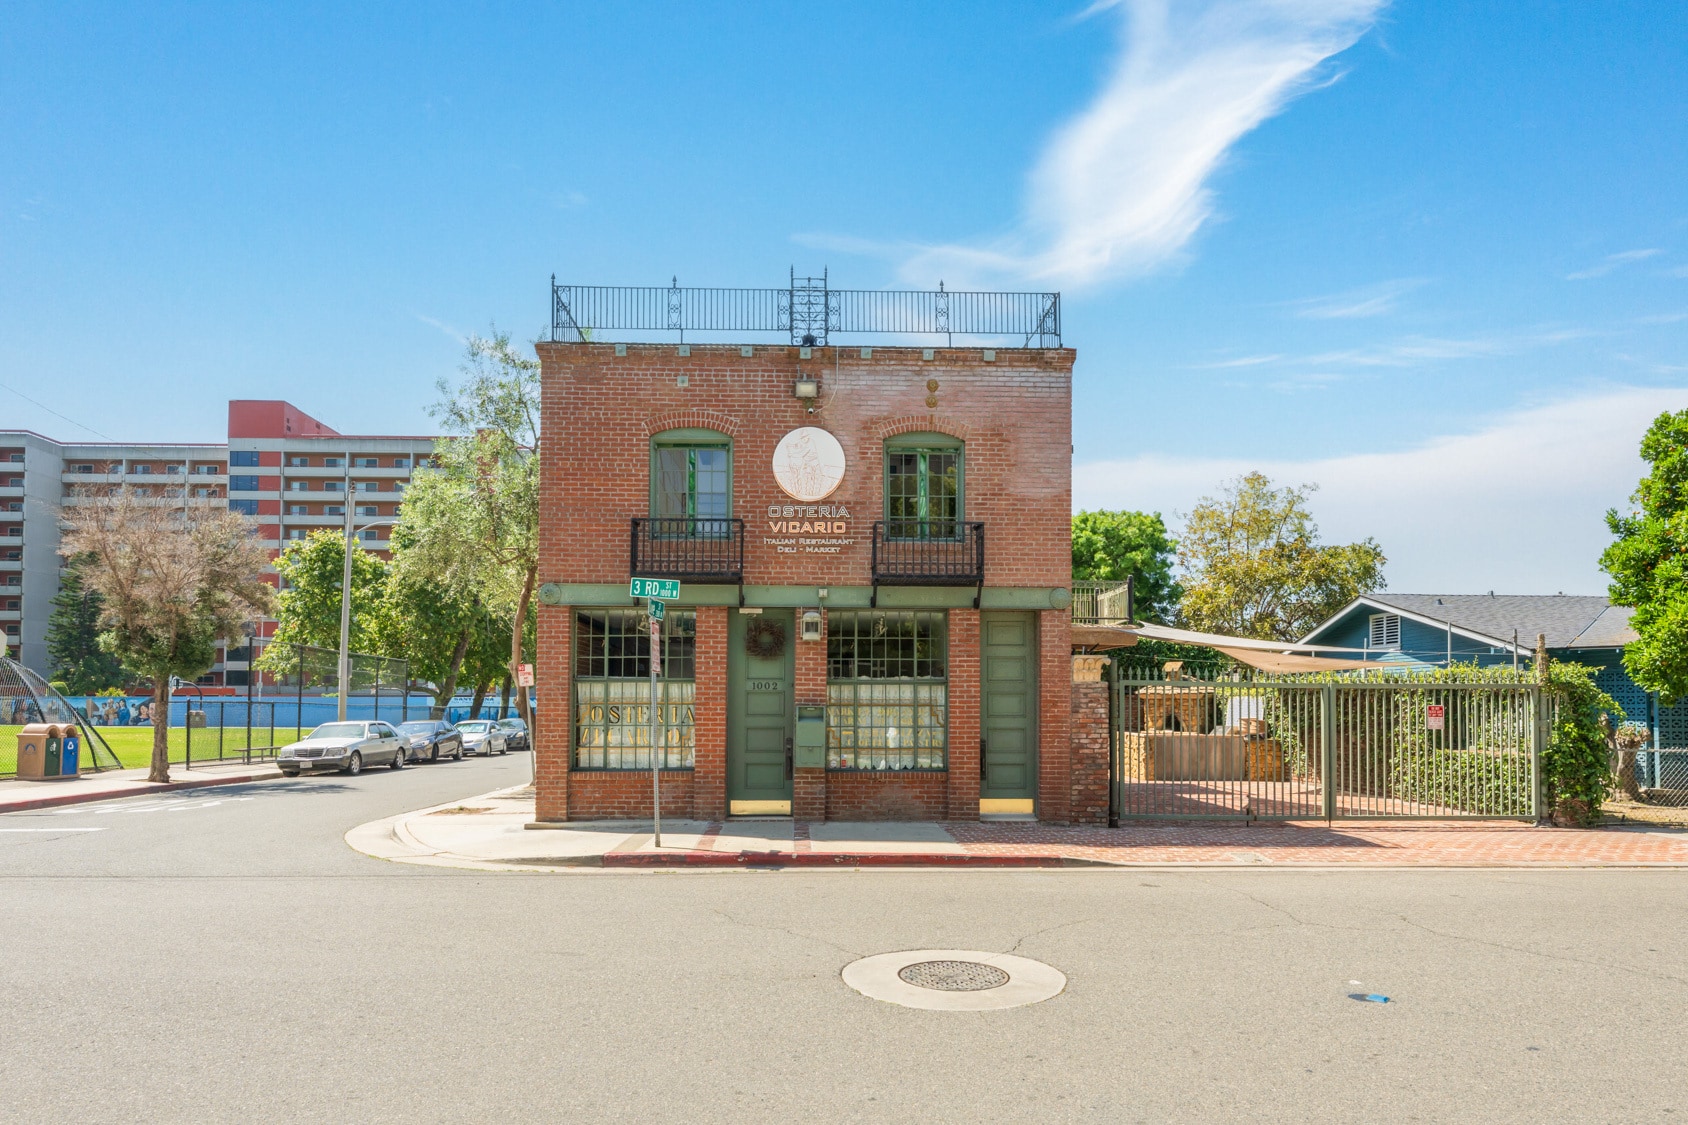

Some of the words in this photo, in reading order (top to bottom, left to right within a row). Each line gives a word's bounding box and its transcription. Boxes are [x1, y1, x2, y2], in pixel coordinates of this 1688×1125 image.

[768, 505, 850, 518] OSTERIA
[769, 521, 846, 533] VICARIO
[634, 581, 640, 594] 3
[645, 581, 659, 595] RD
[752, 682, 778, 690] 1002
[591, 706, 695, 723] OSTERIA
[581, 728, 681, 745] VICARO
